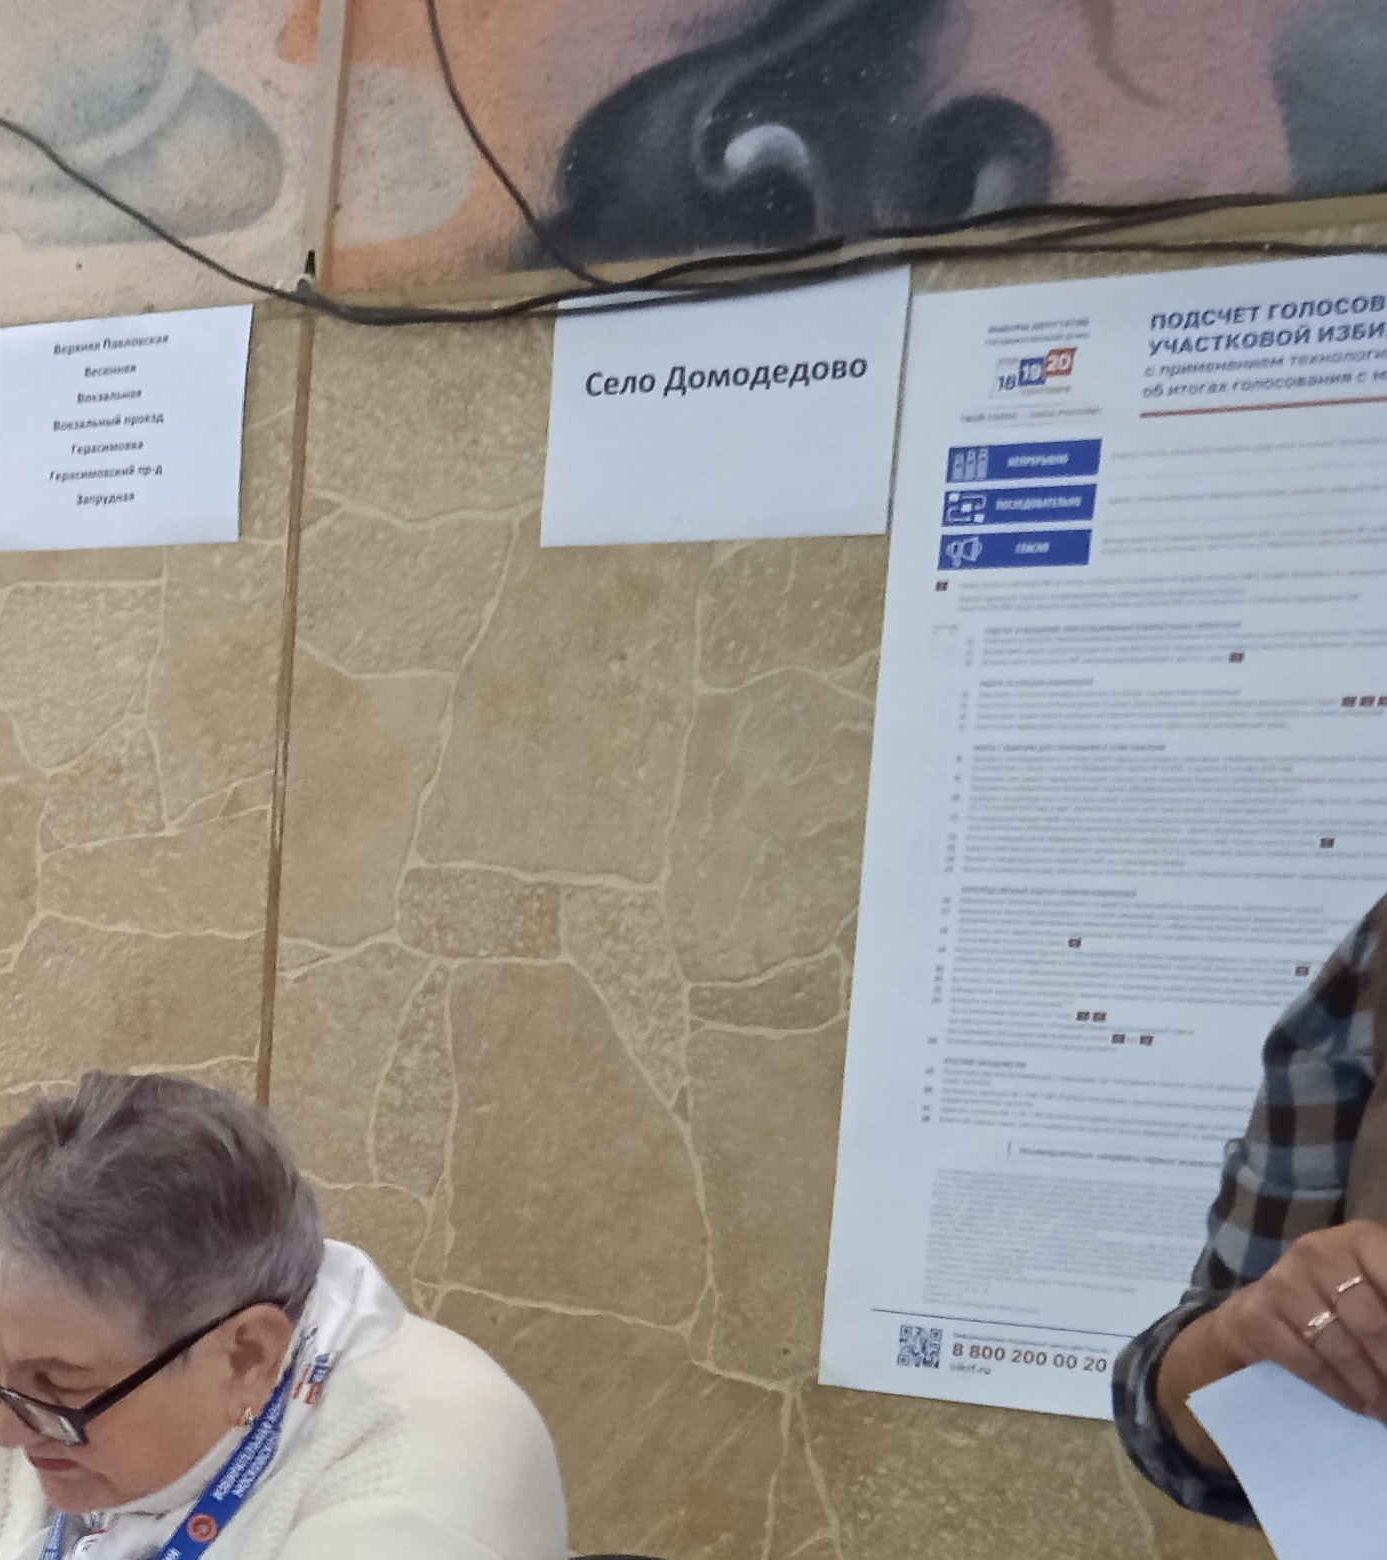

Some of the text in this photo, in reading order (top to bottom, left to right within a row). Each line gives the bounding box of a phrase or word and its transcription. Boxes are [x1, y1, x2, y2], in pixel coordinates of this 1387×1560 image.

[1149, 294, 1386, 331] ПОДСЧЕТ ГОЛОСОВ
[53, 334, 169, 356] Верхняя Павловская
[1149, 321, 1387, 357] УЧАСТКОВОЙ ИЗБИ
[84, 364, 137, 378] Весенняя
[585, 357, 868, 398] Село Домодедово
[998, 374, 1017, 391] 18
[1045, 352, 1072, 372] 20
[1160, 357, 1284, 377] применением
[1142, 384, 1164, 399] об
[1166, 381, 1227, 397] итогах
[1232, 372, 1353, 392] голосования
[77, 389, 142, 404] Вокзальная
[53, 413, 164, 432] Вокзальный проезд
[72, 441, 144, 455] Герасимовка
[49, 465, 163, 482] Герасимовский пр-д
[76, 492, 135, 506] Запрудная
[952, 1343, 1107, 1373] 8 800 200 00 20
